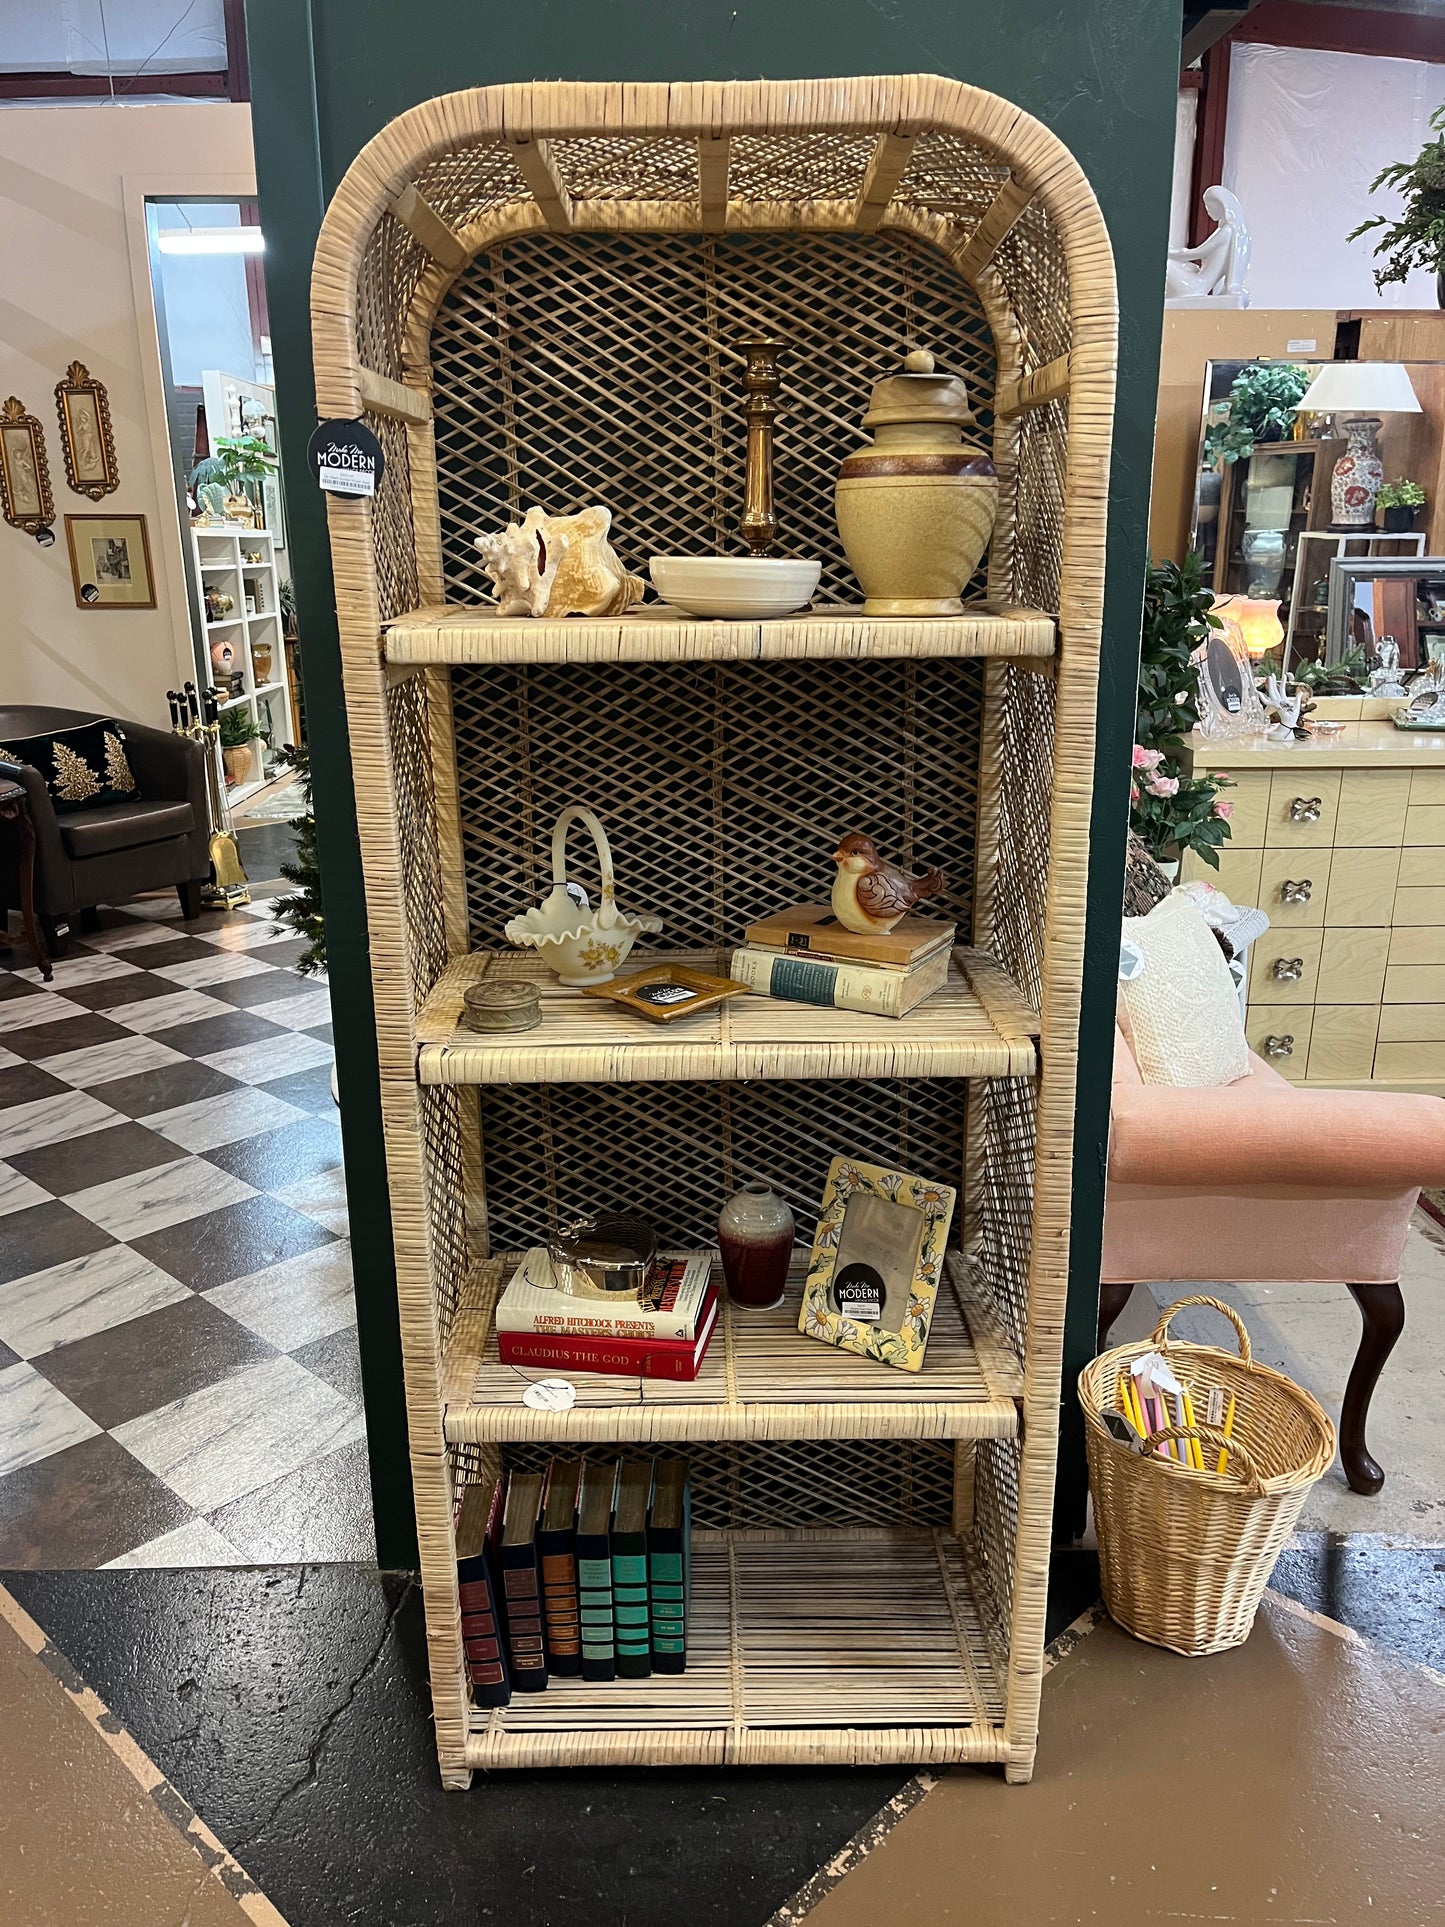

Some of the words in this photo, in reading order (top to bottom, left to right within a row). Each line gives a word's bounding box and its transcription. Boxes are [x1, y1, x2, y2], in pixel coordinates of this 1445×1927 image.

[317, 452, 375, 469] MODERN
[839, 1288, 879, 1298] MODERN
[534, 1315, 564, 1326] ALFRED
[567, 1317, 613, 1328] HITCHCOCK
[534, 1325, 556, 1334] THE
[511, 1346, 570, 1360] CLAUDIUS
[573, 1351, 599, 1362] THE
[602, 1354, 629, 1365] GOD
